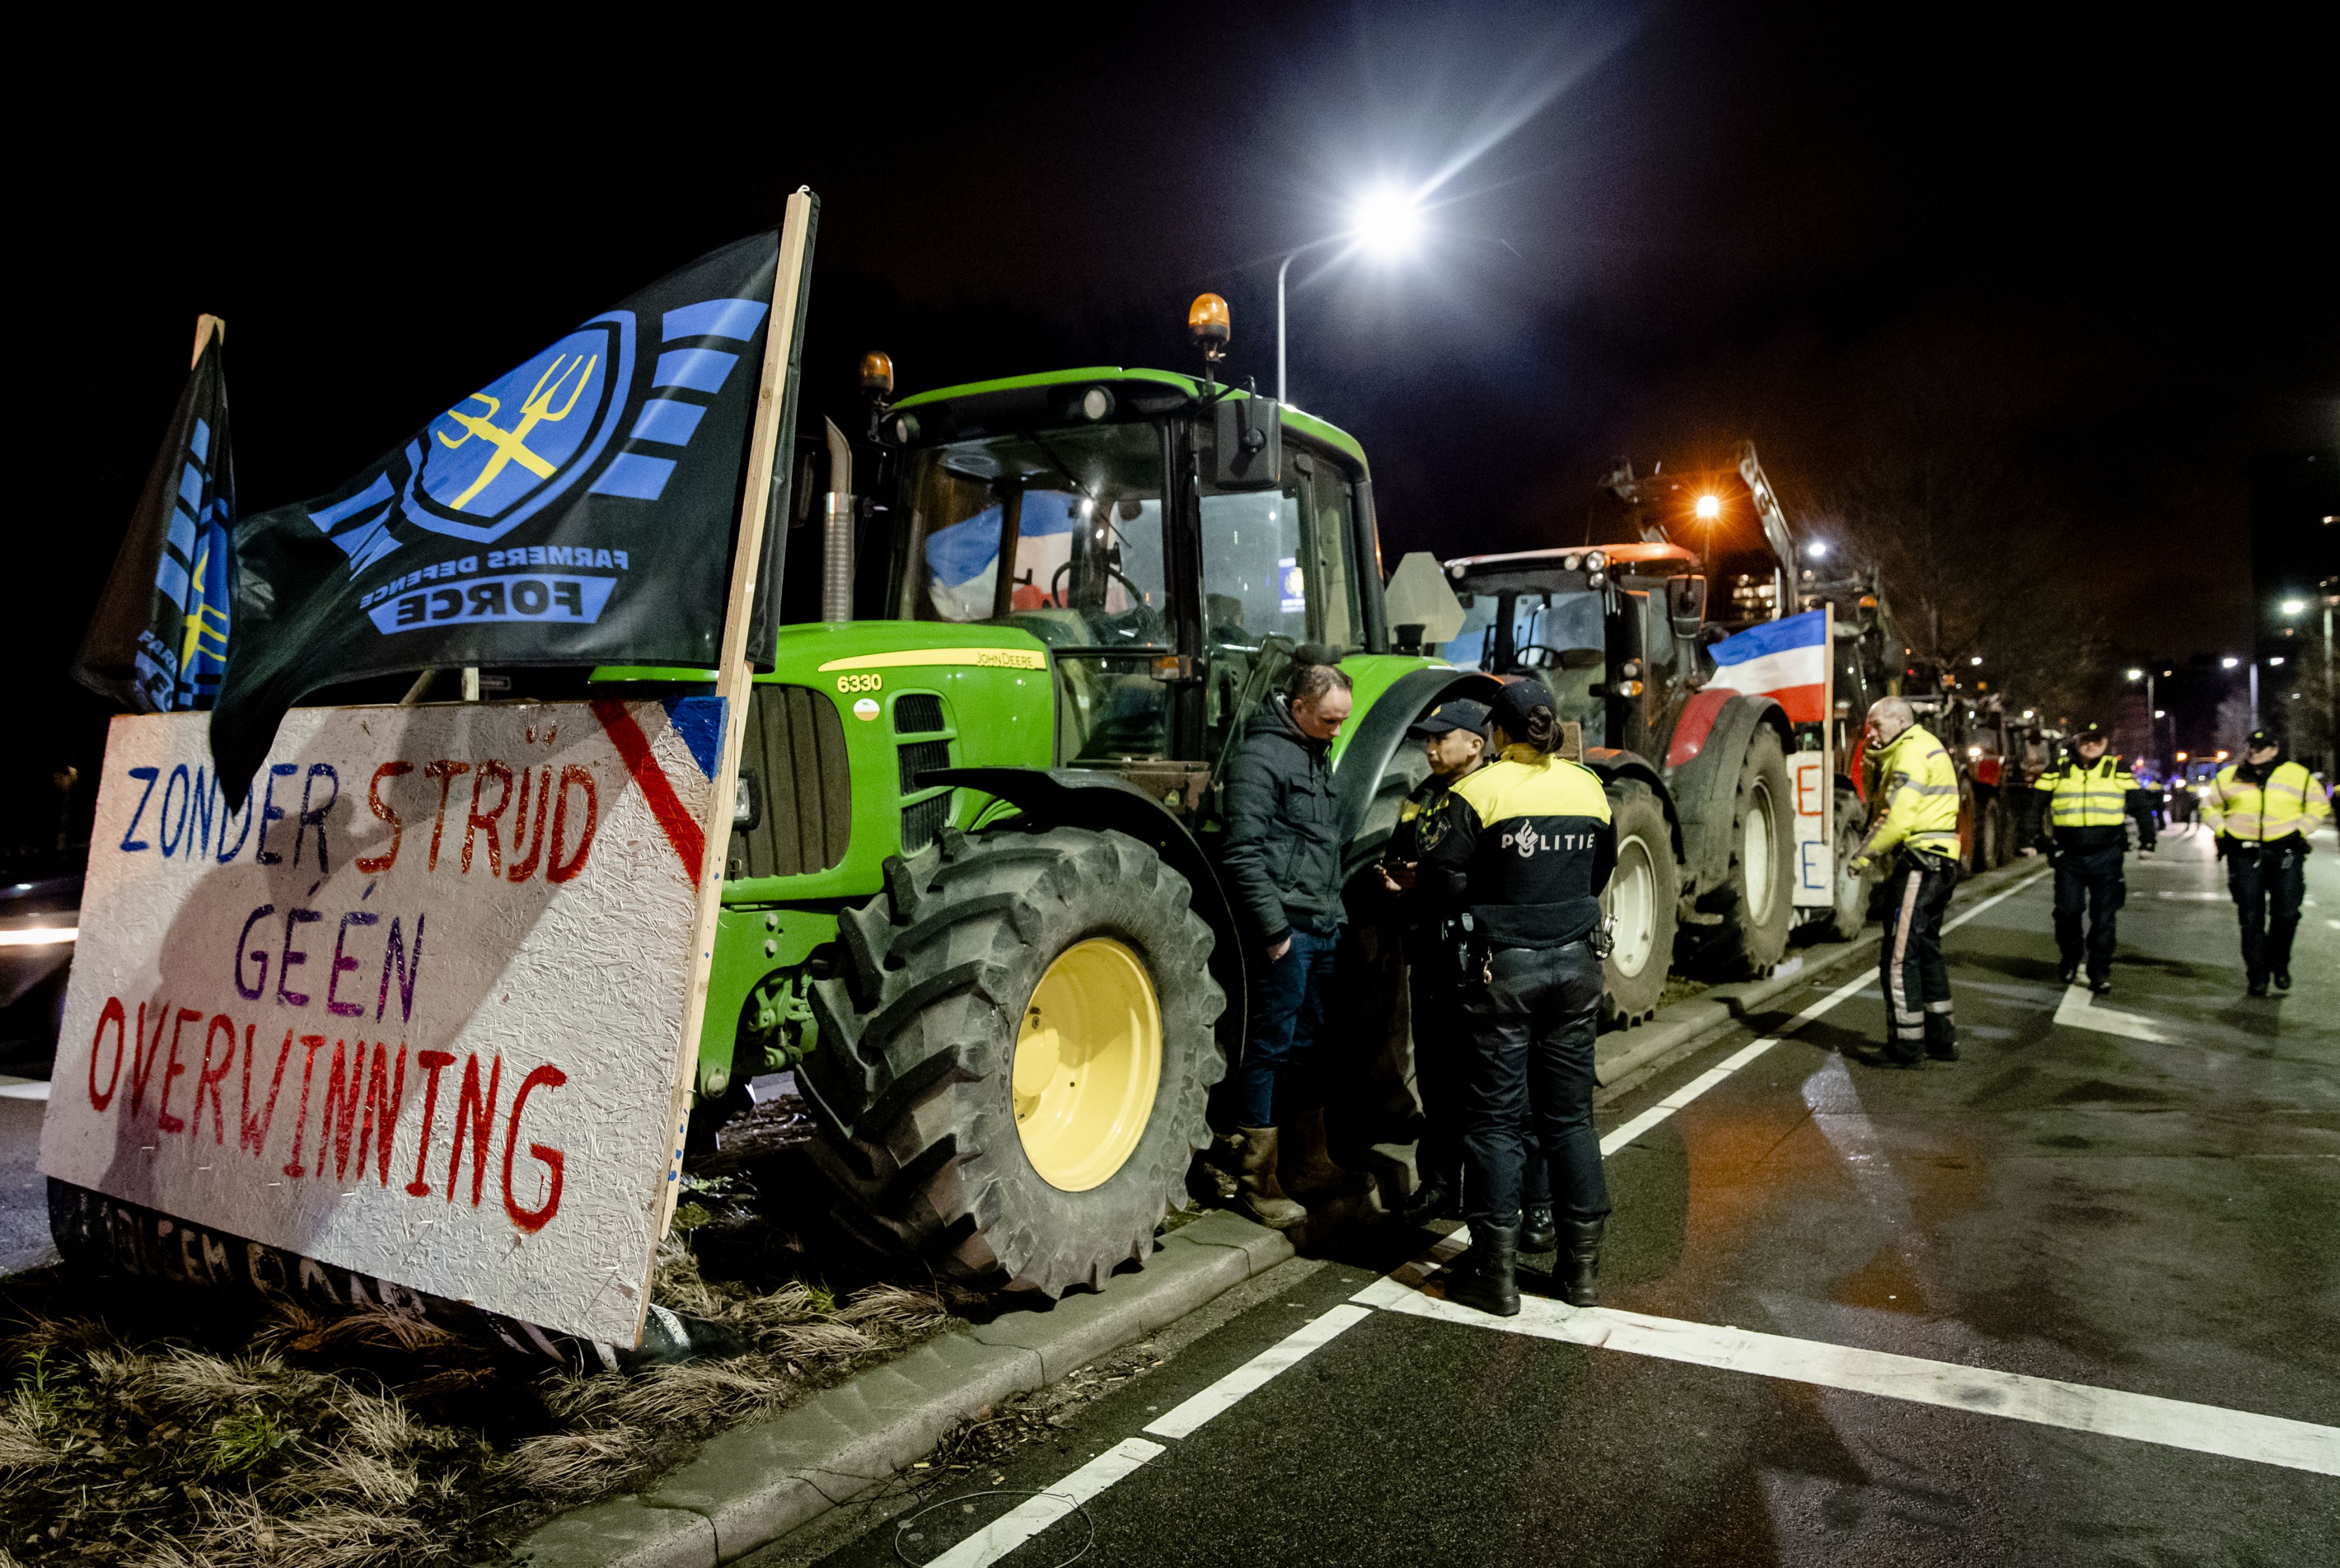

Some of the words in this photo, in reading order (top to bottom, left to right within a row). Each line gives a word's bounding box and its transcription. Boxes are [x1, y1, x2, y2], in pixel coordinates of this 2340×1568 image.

[837, 673, 882, 694] 6330
[977, 652, 1002, 665] JOHN
[1002, 653, 1033, 668] DEERE
[121, 763, 339, 874] ZONDER
[356, 720, 597, 884] STRIJD
[235, 881, 425, 1023] GÉÉN
[88, 996, 567, 1235] OVERWINNING
